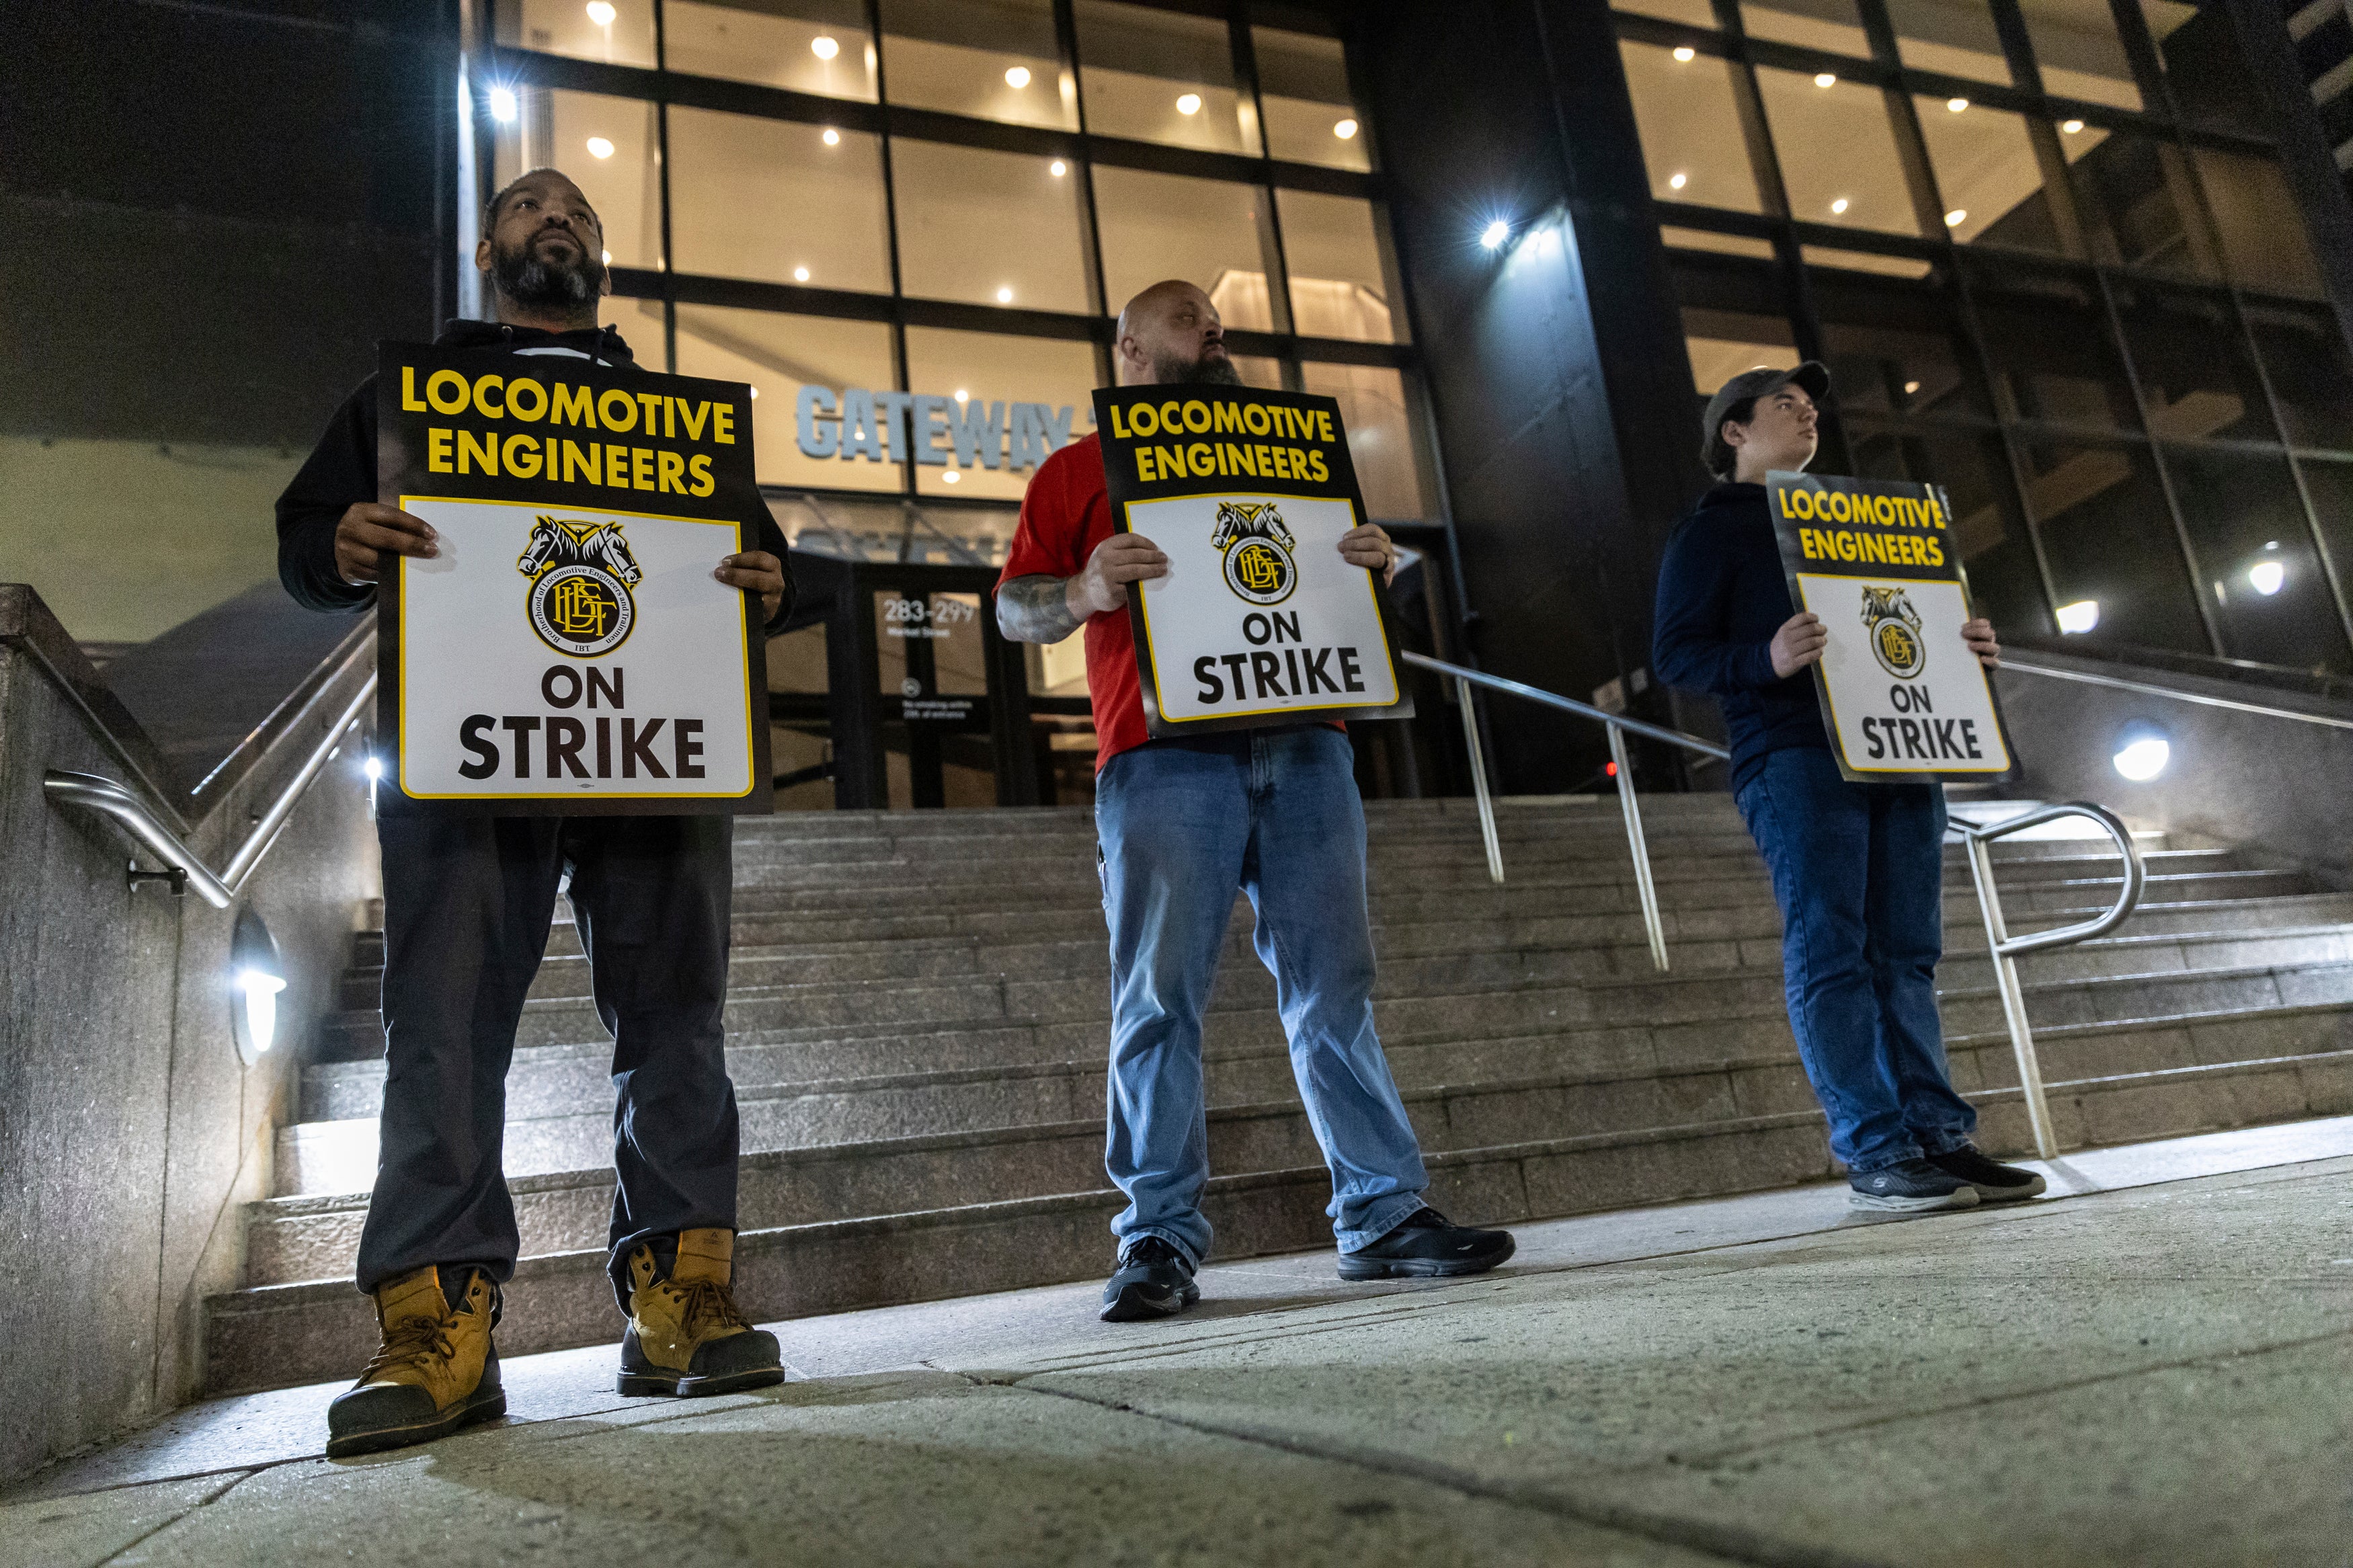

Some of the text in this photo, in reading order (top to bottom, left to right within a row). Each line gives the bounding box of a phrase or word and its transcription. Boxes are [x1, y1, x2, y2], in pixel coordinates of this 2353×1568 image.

[402, 366, 735, 444] LOCOMOTIVE
[1110, 400, 1336, 442] LOCOMOTIVE
[796, 384, 1074, 470] GATEWAY
[428, 427, 715, 497] ENGINEERS
[1135, 442, 1329, 483] ENGINEERS
[1778, 488, 1946, 530] LOCOMOTIVE
[1799, 528, 1944, 567] ENGINEERS
[535, 567, 629, 645] Brotherhood of Locomotive Engineers and Trainmen
[883, 599, 975, 624] 283-299
[1242, 611, 1302, 645] ON
[541, 665, 624, 709] ON
[1193, 647, 1365, 704] STRIKE
[1890, 684, 1933, 713] ON
[458, 714, 705, 780] STRIKE
[1862, 716, 1983, 759] STRIKE
